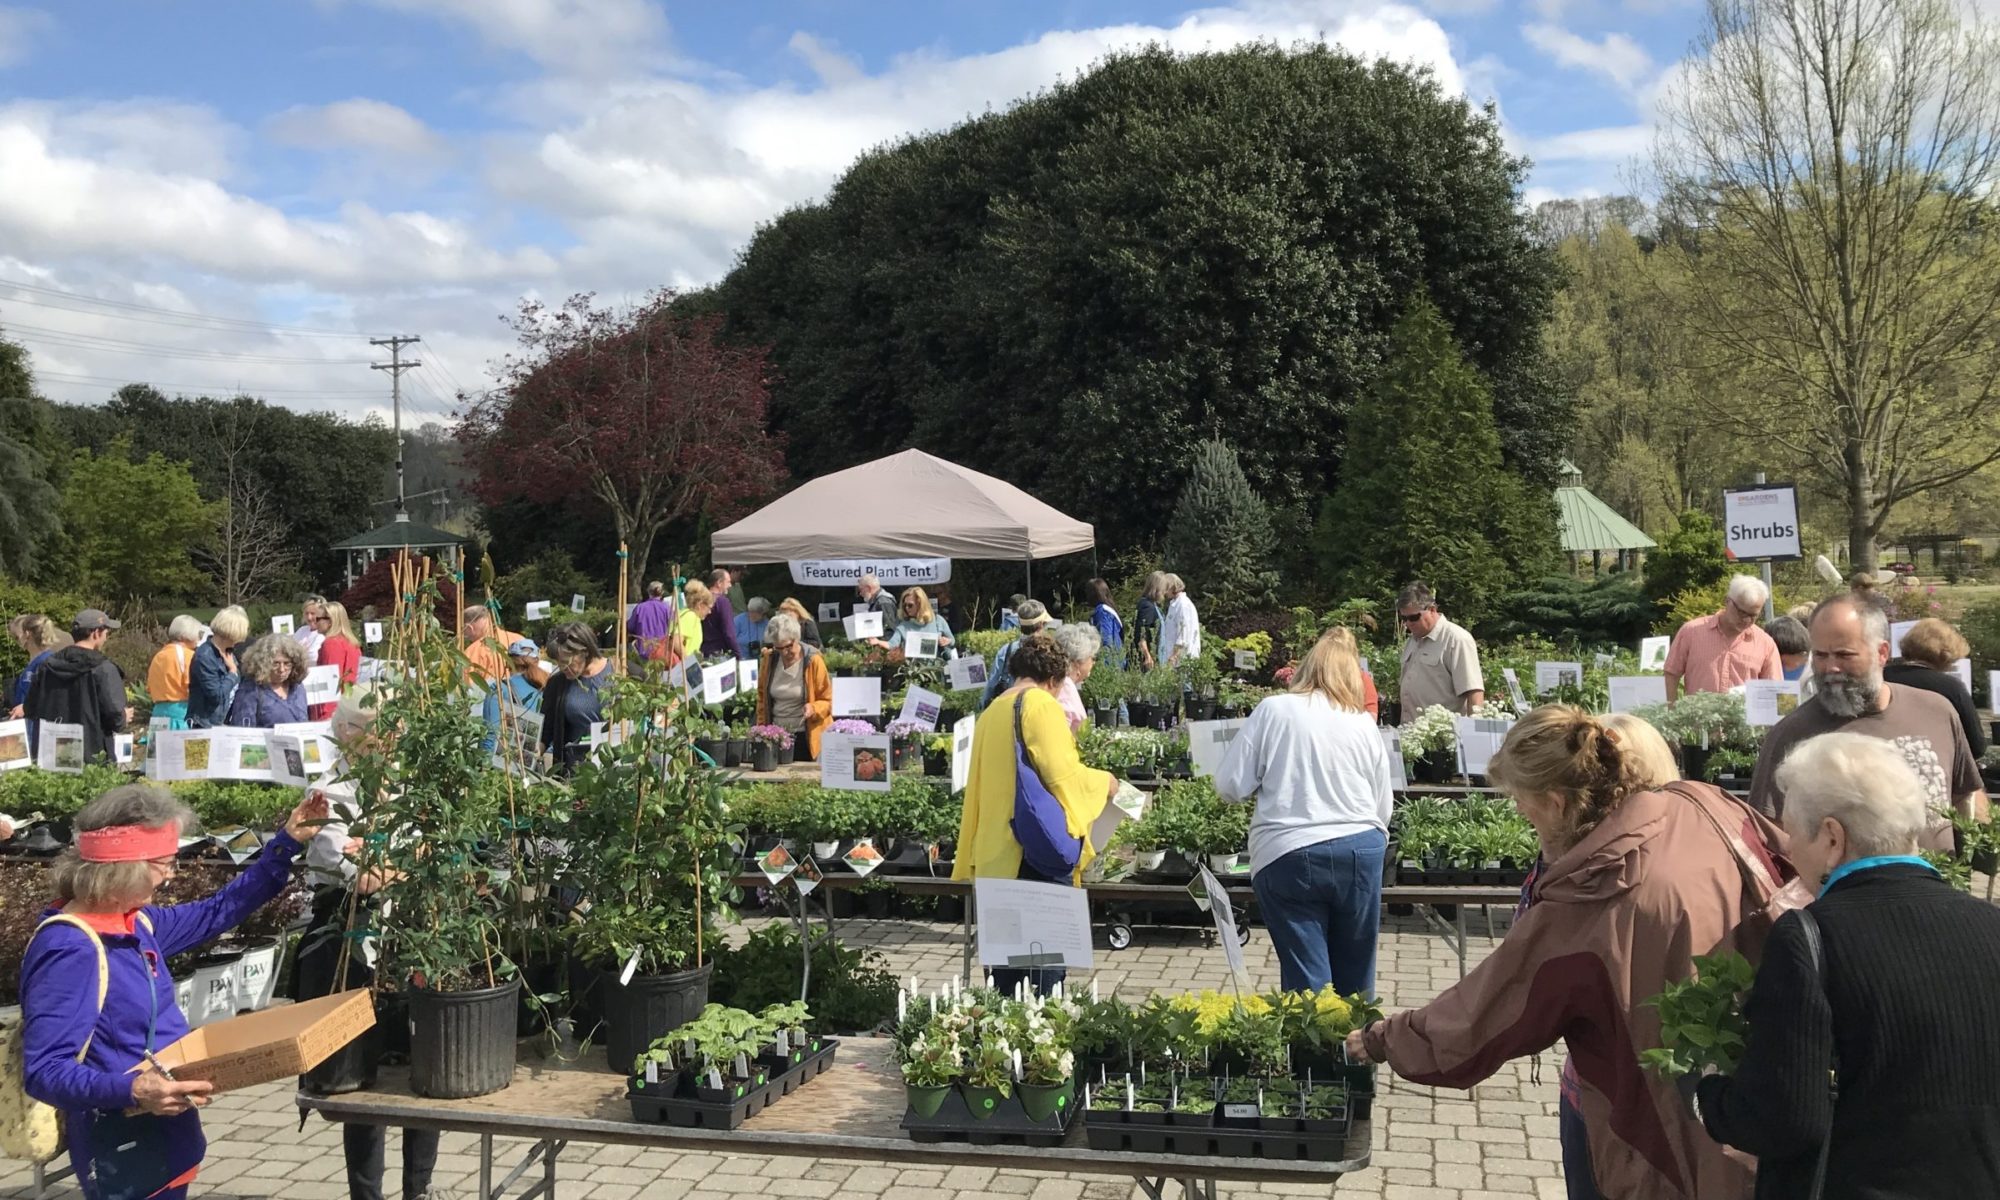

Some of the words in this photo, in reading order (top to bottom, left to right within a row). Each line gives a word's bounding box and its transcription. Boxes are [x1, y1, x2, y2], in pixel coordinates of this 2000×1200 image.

[1731, 521, 1794, 541] Shrubs
[805, 565, 862, 578] Featured
[865, 565, 899, 578] Plant
[902, 565, 932, 577] Tent
